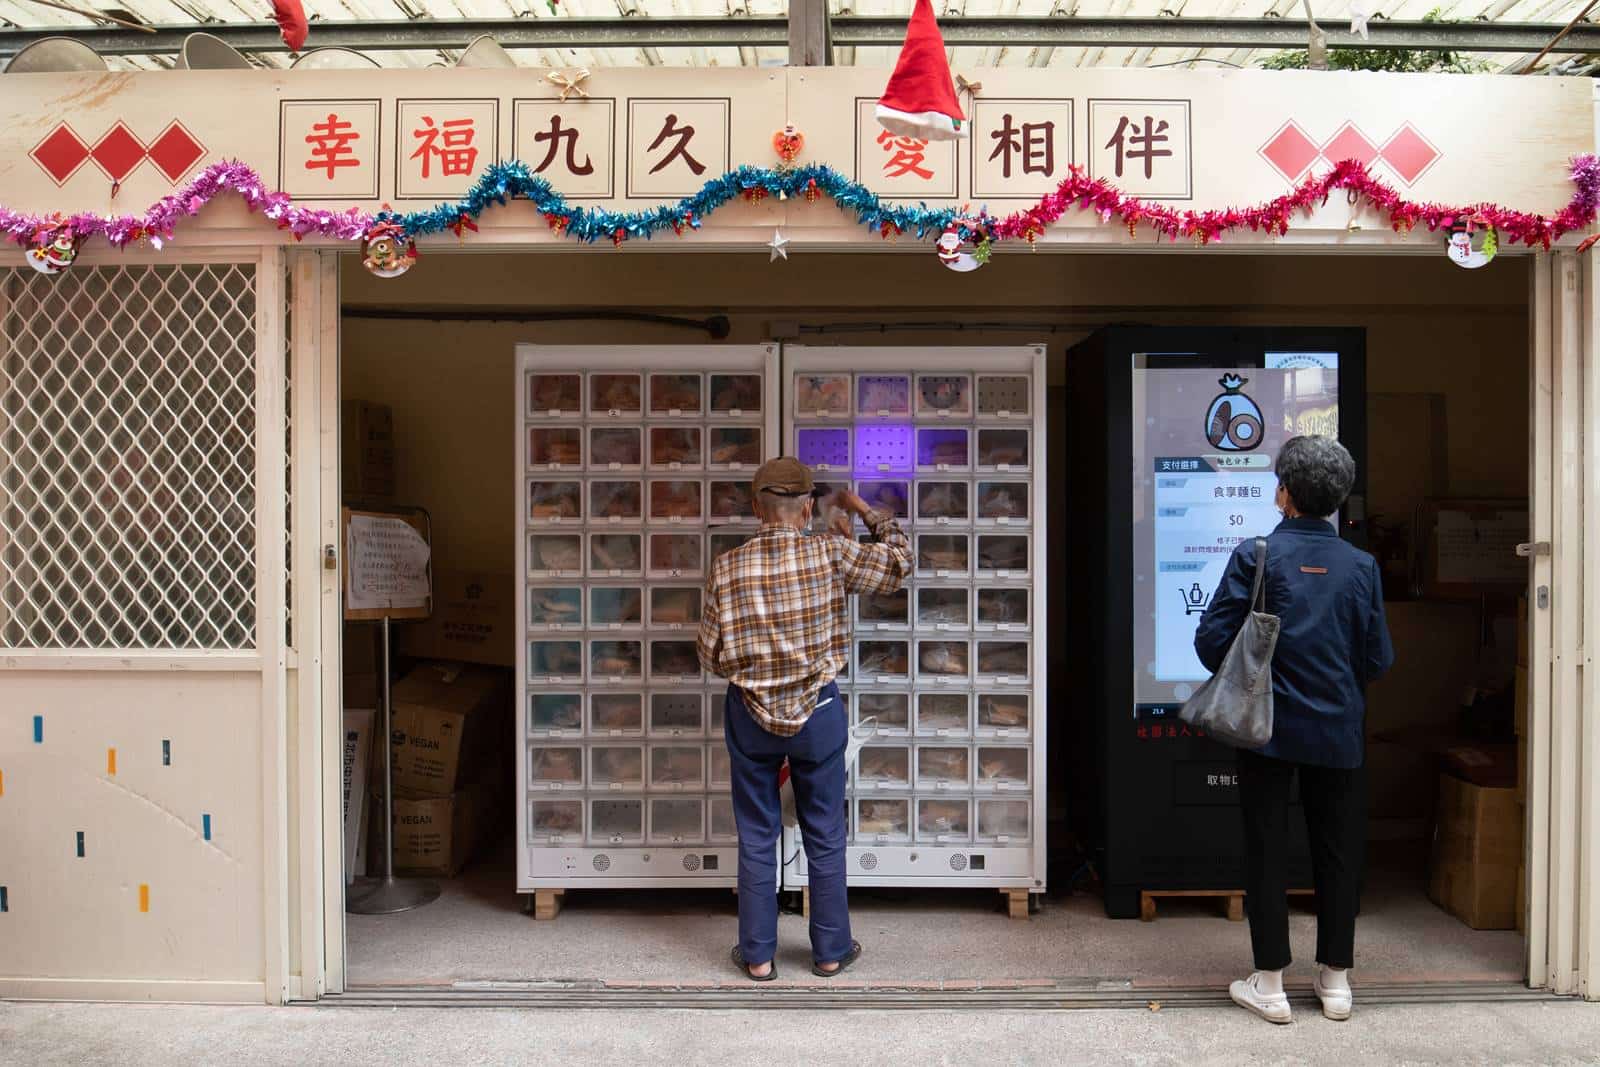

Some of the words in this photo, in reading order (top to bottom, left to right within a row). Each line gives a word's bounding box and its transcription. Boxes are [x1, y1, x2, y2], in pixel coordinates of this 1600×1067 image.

[305, 113, 706, 179] 幸福九久
[876, 113, 1173, 179] 愛相伴
[1161, 460, 1199, 471] 支付選擇
[1213, 486, 1262, 498] 食享麵包
[1229, 514, 1244, 526] $0
[409, 736, 440, 750] VEGAN
[401, 815, 432, 825] VEGAN
